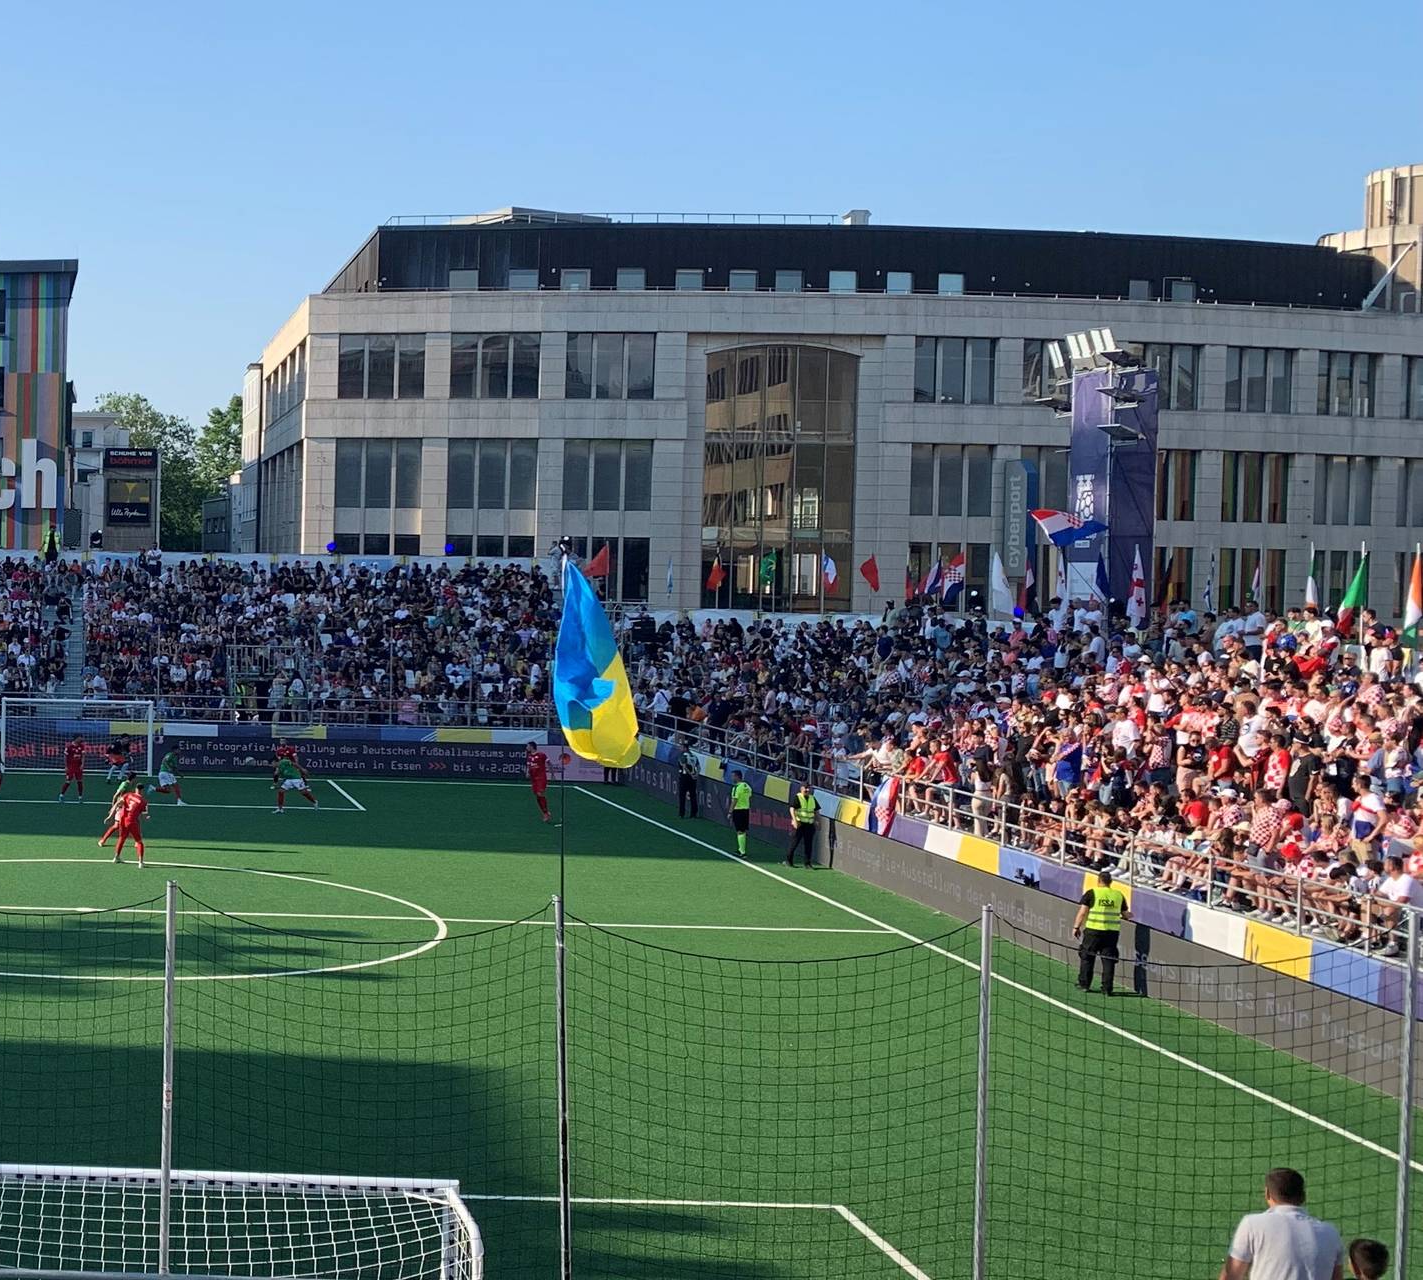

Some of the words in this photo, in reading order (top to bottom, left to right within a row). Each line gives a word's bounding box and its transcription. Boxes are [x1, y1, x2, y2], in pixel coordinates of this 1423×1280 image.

[1008, 474, 1022, 569] cyberport
[178, 740, 203, 751] Eine
[339, 745, 359, 754] des
[362, 744, 417, 756] Deutschen
[508, 750, 527, 758] und
[178, 756, 195, 766] des
[202, 757, 227, 766] Ruhr
[306, 758, 366, 769] Zollverein
[373, 760, 385, 770] in
[390, 760, 422, 771] Essen
[453, 763, 472, 772] bis
